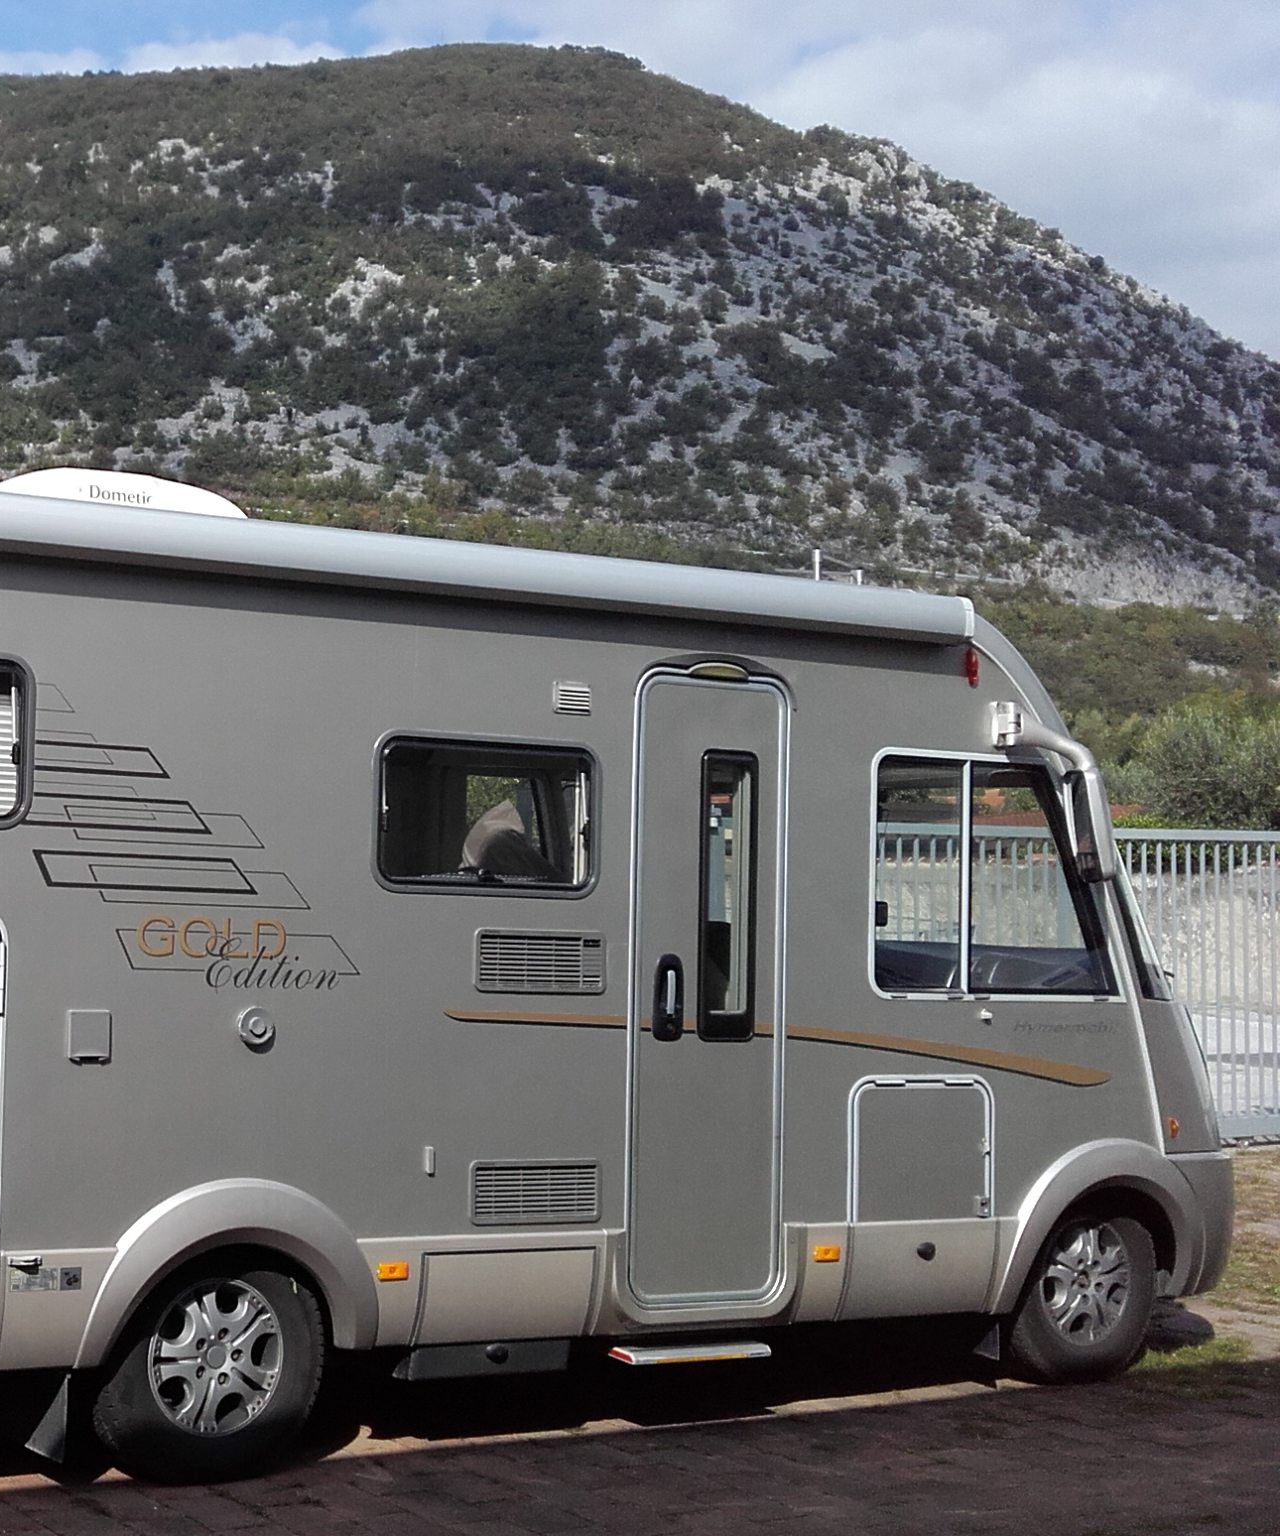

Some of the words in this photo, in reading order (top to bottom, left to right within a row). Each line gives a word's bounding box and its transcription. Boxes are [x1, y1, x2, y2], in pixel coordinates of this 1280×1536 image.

[89, 484, 152, 504] Dometic
[136, 915, 288, 960] GOLD
[205, 935, 340, 994] Edition
